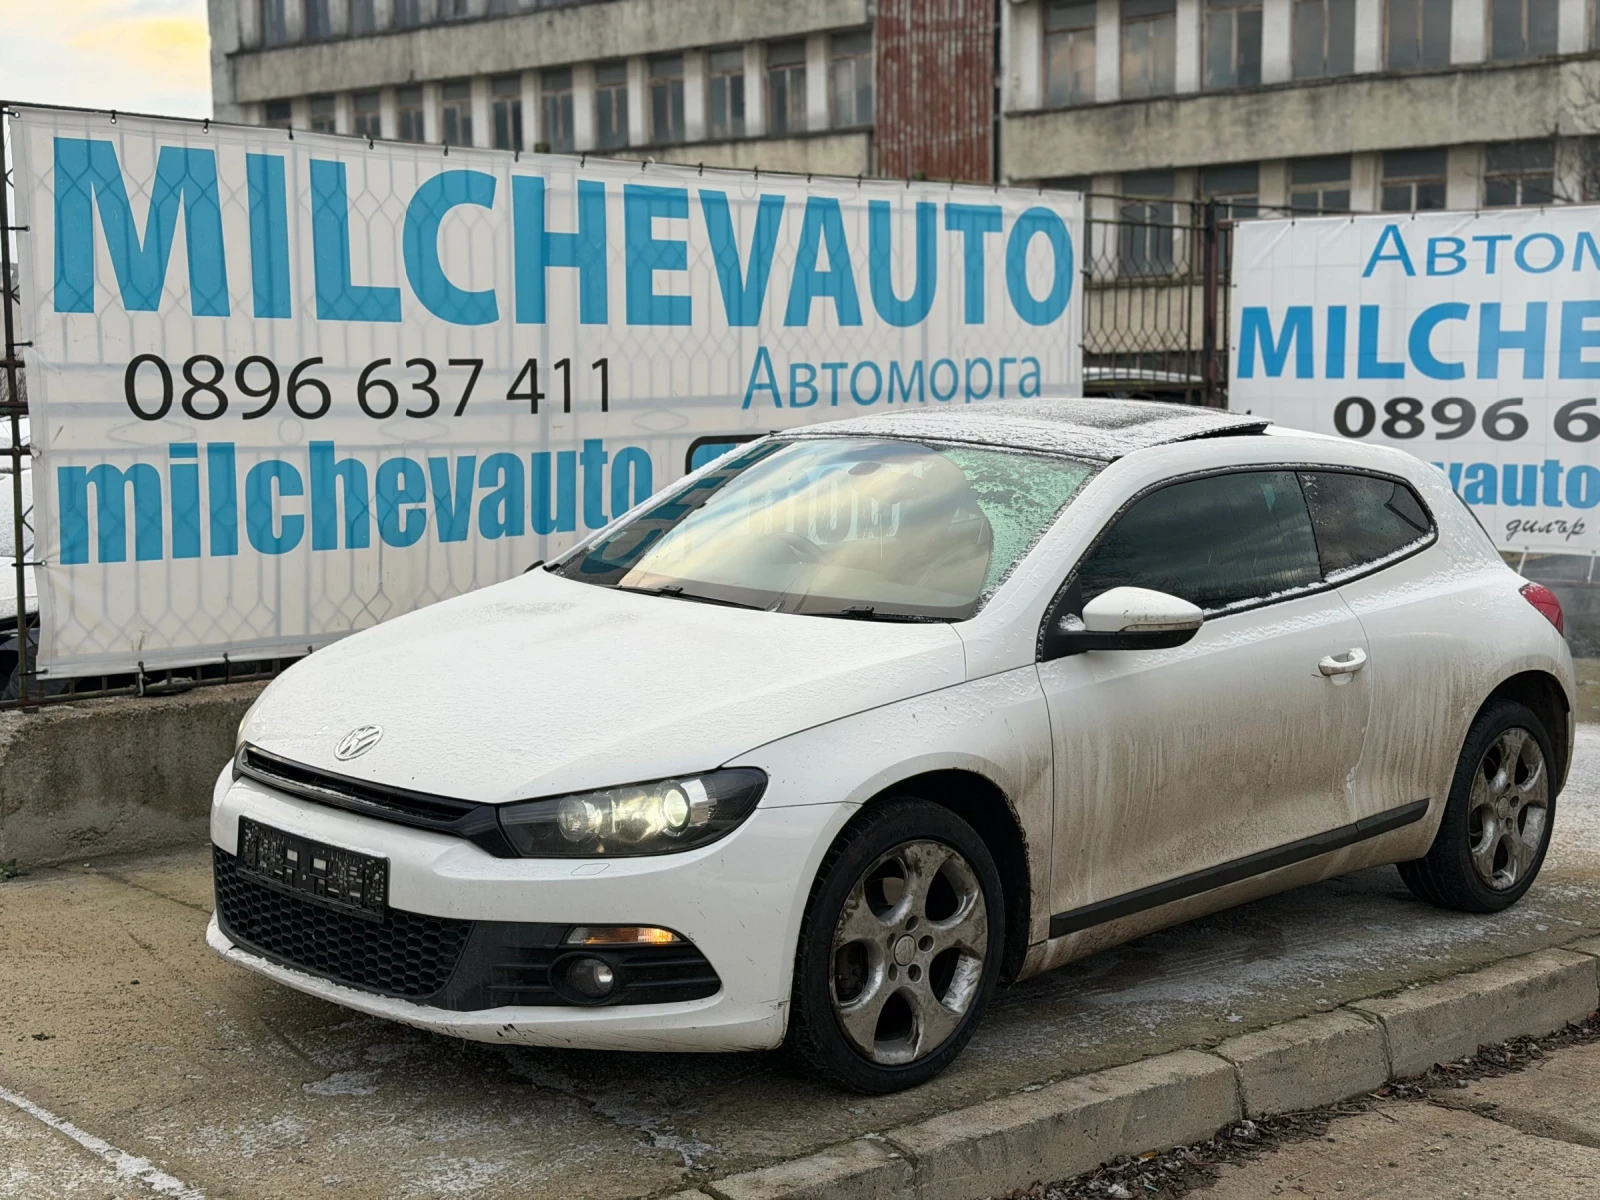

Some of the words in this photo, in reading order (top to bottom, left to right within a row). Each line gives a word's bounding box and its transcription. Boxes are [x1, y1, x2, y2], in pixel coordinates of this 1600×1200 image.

[54, 137, 1074, 327] MILCHEVAUTO
[1237, 301, 1600, 380] MILCHE
[124, 353, 331, 421] 0896
[357, 357, 484, 420] 637
[506, 357, 609, 415] 411
[741, 346, 1041, 409] Автоморга
[1333, 396, 1529, 441] 0896
[57, 439, 652, 565] milchevauto
